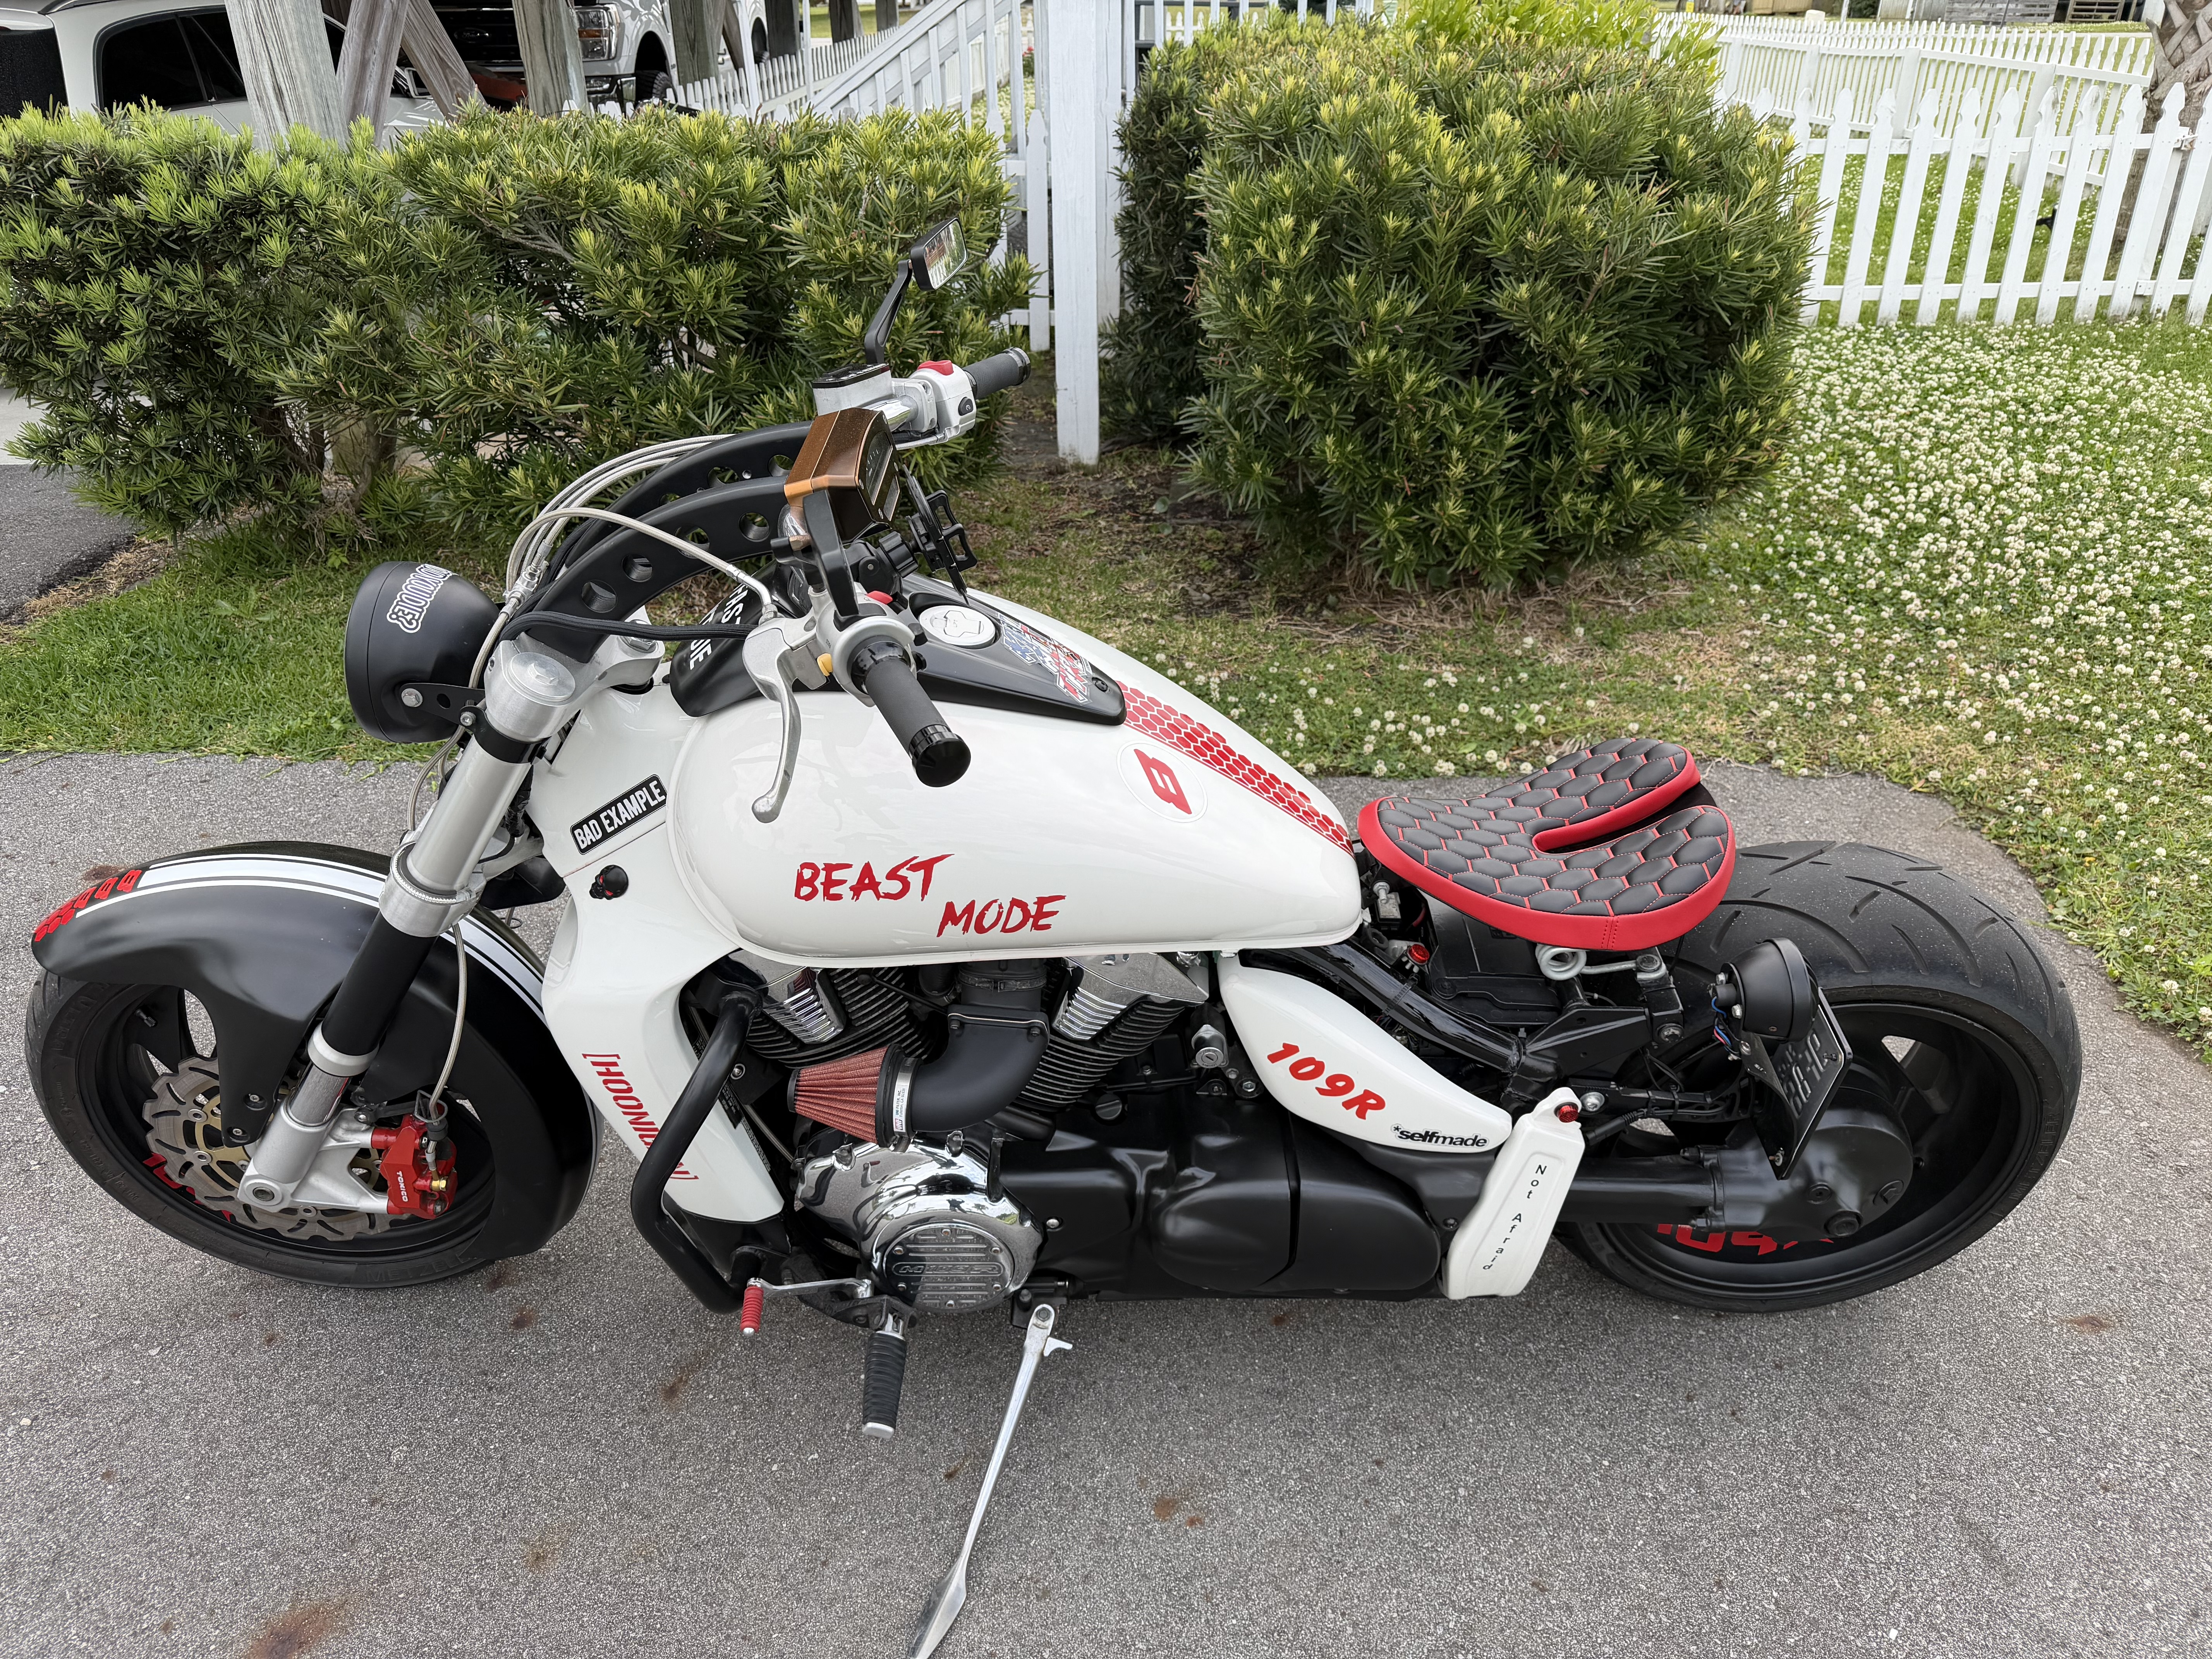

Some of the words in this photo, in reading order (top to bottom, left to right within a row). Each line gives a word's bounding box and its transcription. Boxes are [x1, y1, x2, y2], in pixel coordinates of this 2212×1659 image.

[574, 820, 603, 849] BAD
[599, 780, 666, 833] EXAMPLE
[794, 854, 955, 902] BEAST
[936, 895, 1067, 938] MODE
[1267, 1042, 1386, 1120] 109R
[396, 1170, 409, 1202] TOKICO
[1527, 1164, 1547, 1199] Not
[1482, 1212, 1522, 1270] Afraid
[898, 1264, 999, 1274] M109R
